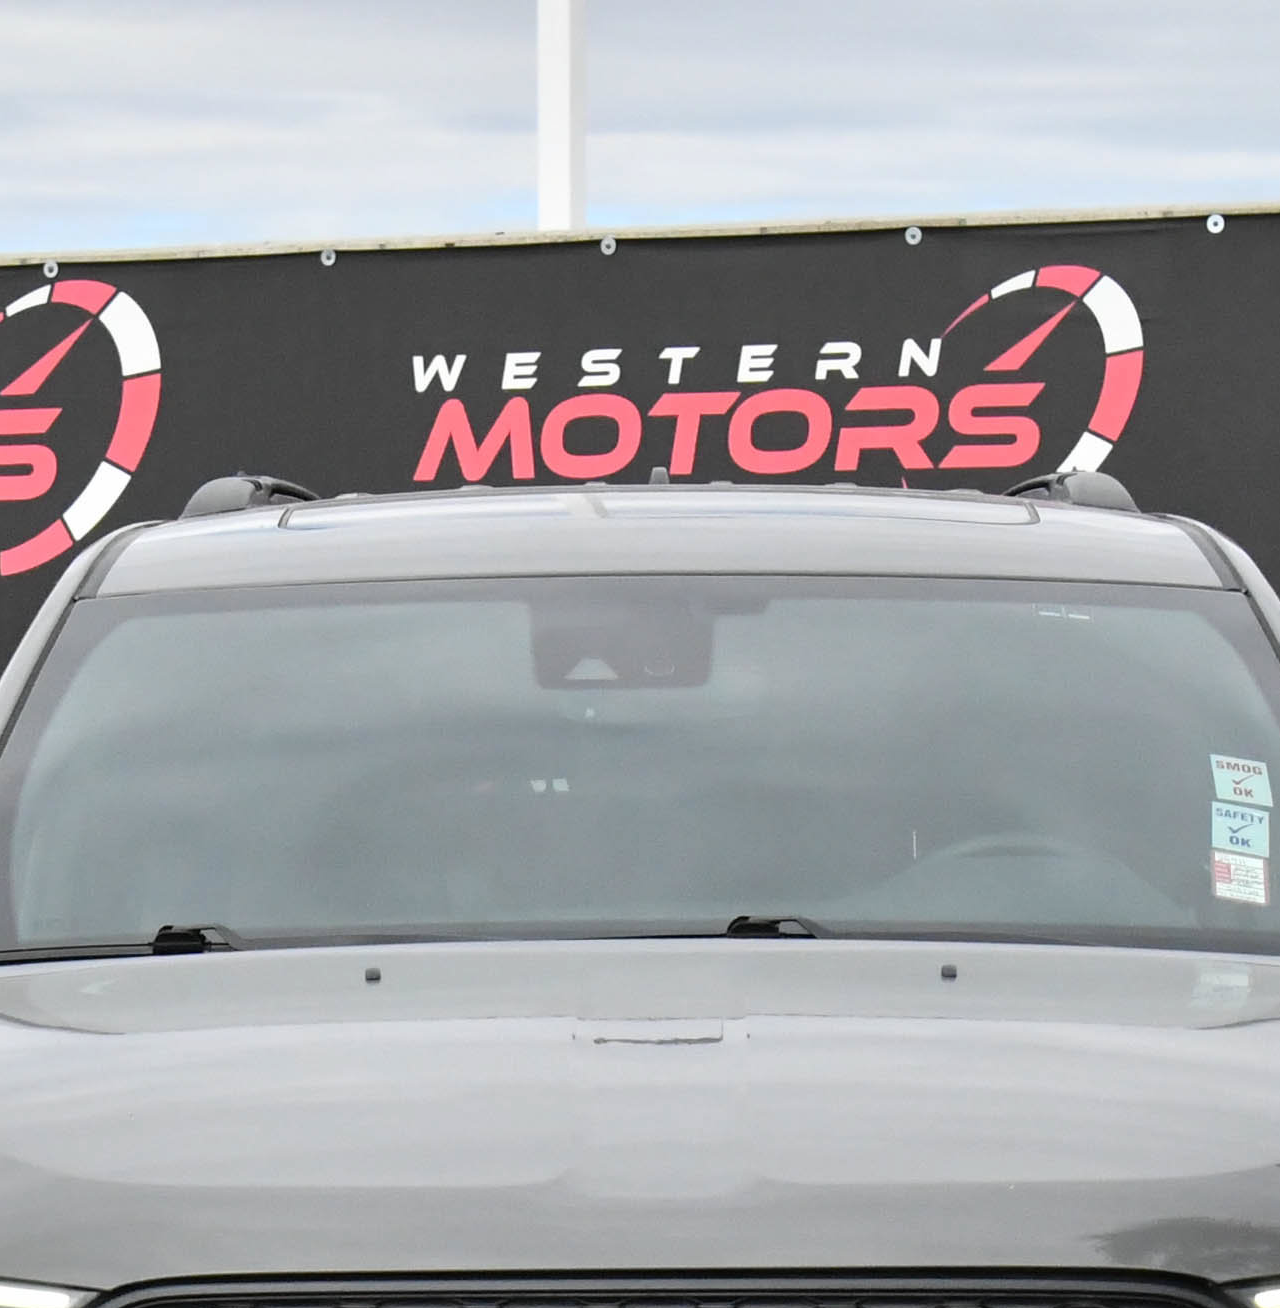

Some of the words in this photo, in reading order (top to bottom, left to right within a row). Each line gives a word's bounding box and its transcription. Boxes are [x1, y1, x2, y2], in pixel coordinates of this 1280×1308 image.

[412, 338, 943, 393] WESTERN
[412, 382, 1046, 482] MOTORS
[1215, 760, 1264, 776] SMOG
[1233, 786, 1255, 798] OK
[1215, 807, 1265, 825] SAFETY
[1229, 835, 1252, 848] OK
